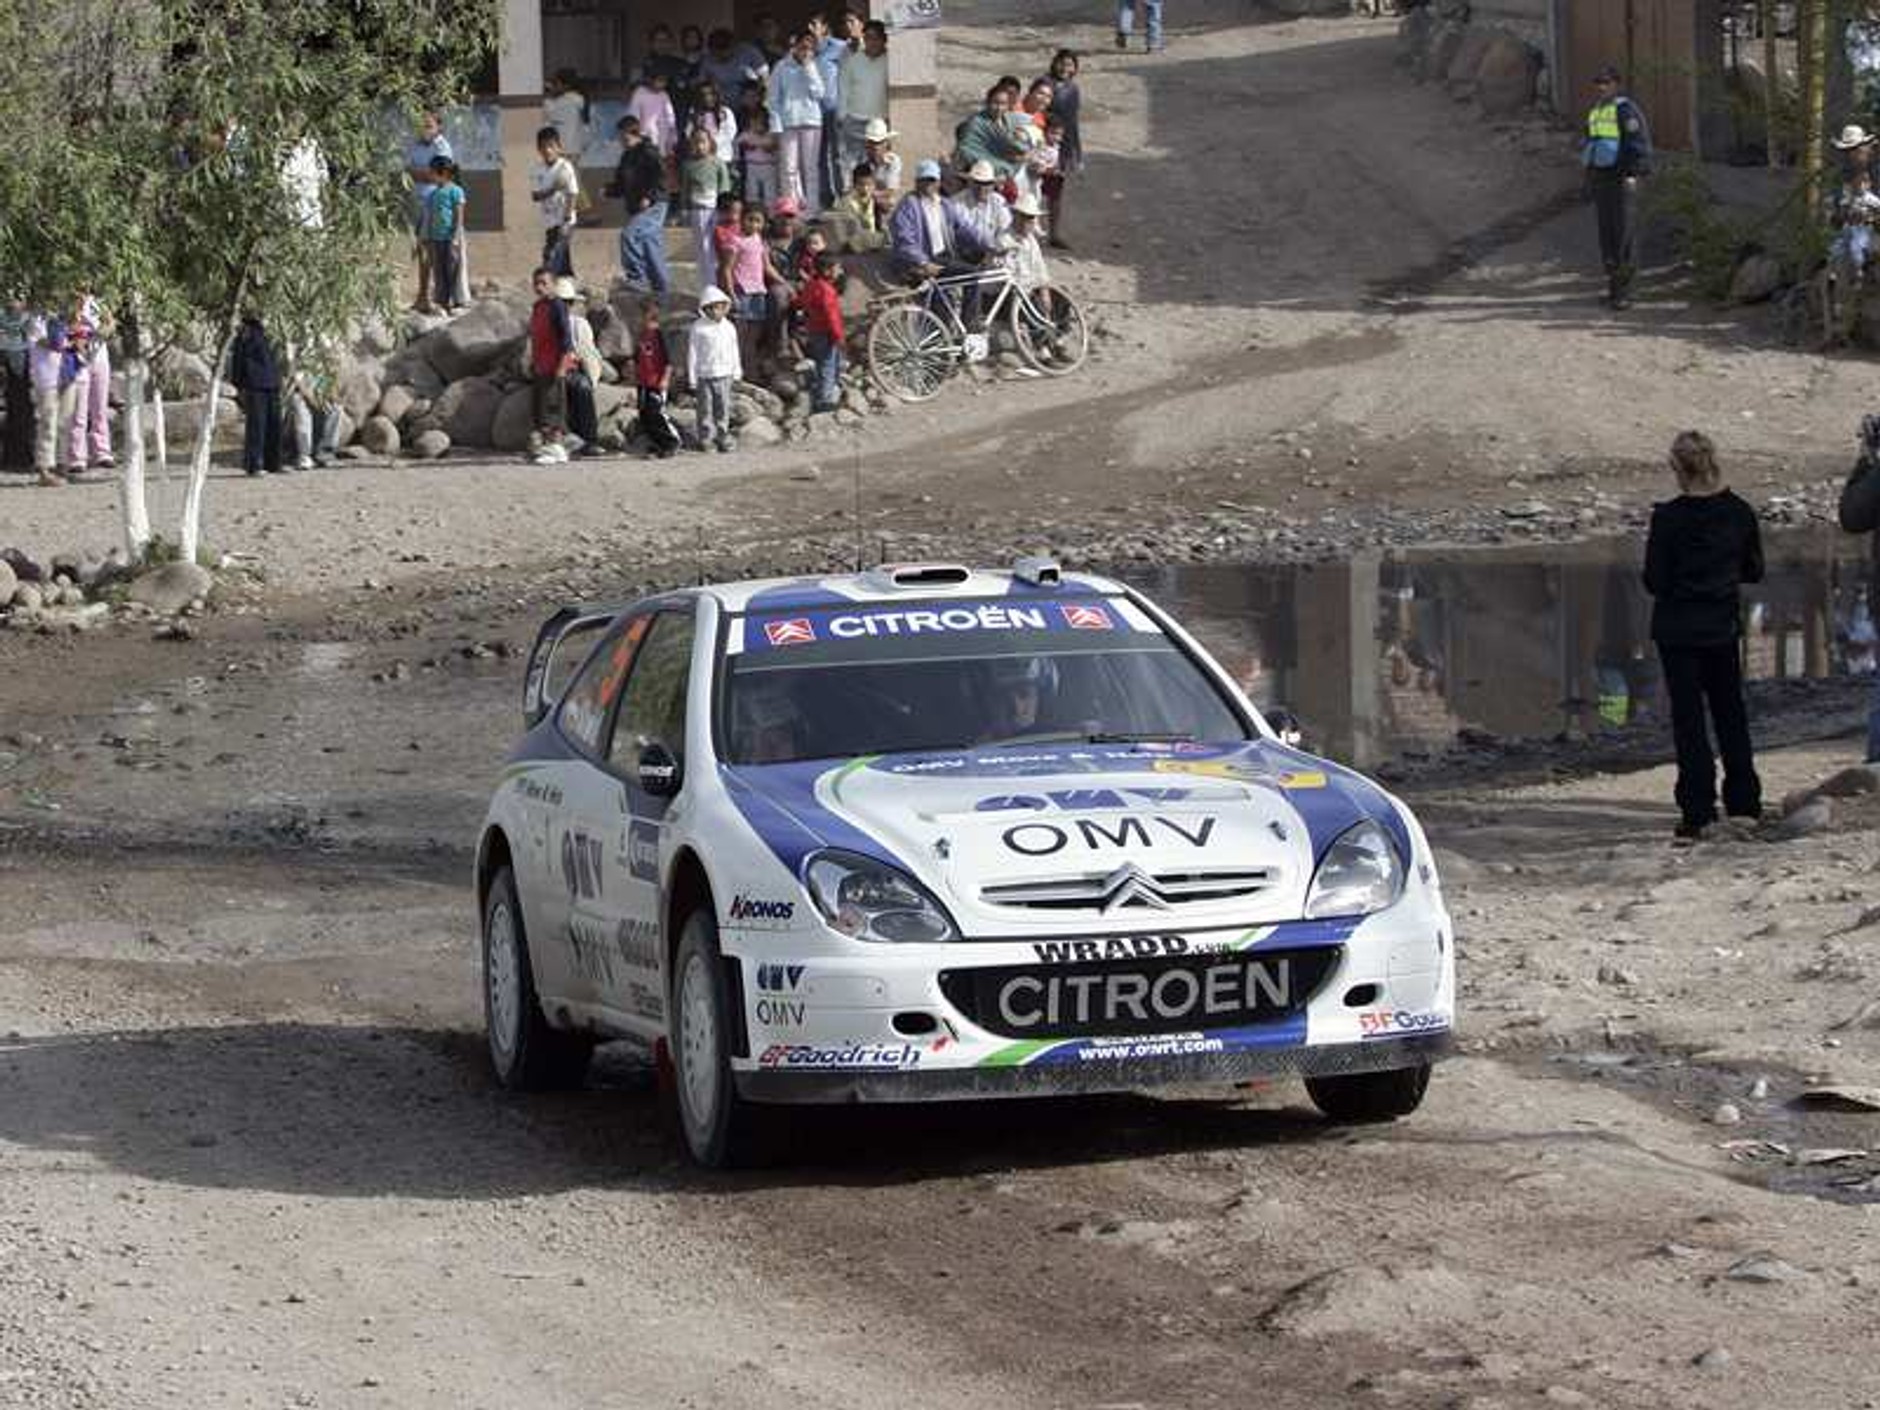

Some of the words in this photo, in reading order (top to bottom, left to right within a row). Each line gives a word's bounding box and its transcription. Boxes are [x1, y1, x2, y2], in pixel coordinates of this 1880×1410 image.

[828, 606, 1047, 638] CITROËN
[1002, 817, 1216, 856] OMV
[730, 895, 796, 920] KRONOS
[756, 999, 805, 1026] OMV
